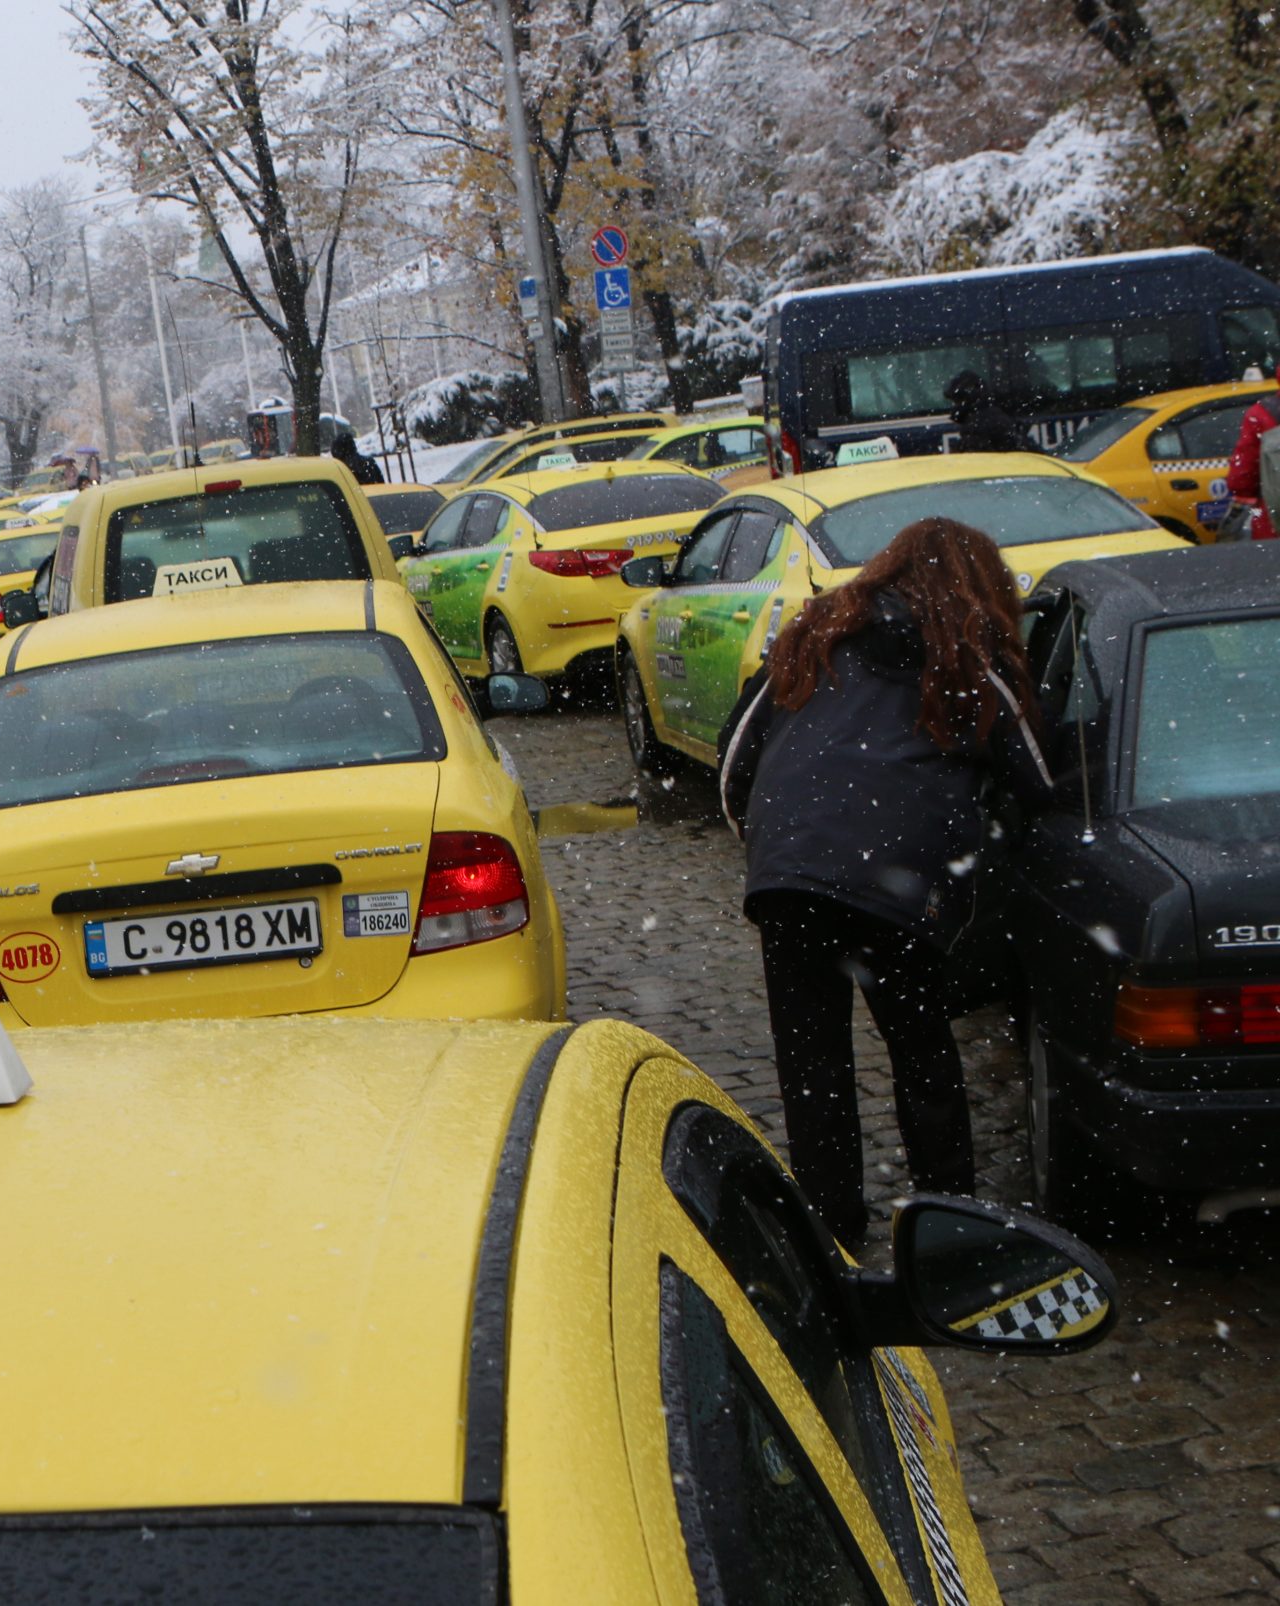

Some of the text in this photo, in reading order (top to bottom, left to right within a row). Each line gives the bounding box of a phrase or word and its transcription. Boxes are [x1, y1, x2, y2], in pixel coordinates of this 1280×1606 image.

[848, 444, 888, 458] ТАКСИ
[545, 457, 571, 466] ТАКСИ
[163, 566, 228, 587] ТАКСИ
[334, 843, 423, 861] CHEVROLET
[361, 912, 408, 932] 186240
[123, 906, 313, 960] C 9818 XM
[1, 943, 54, 971] 4078
[90, 952, 106, 964] BG
